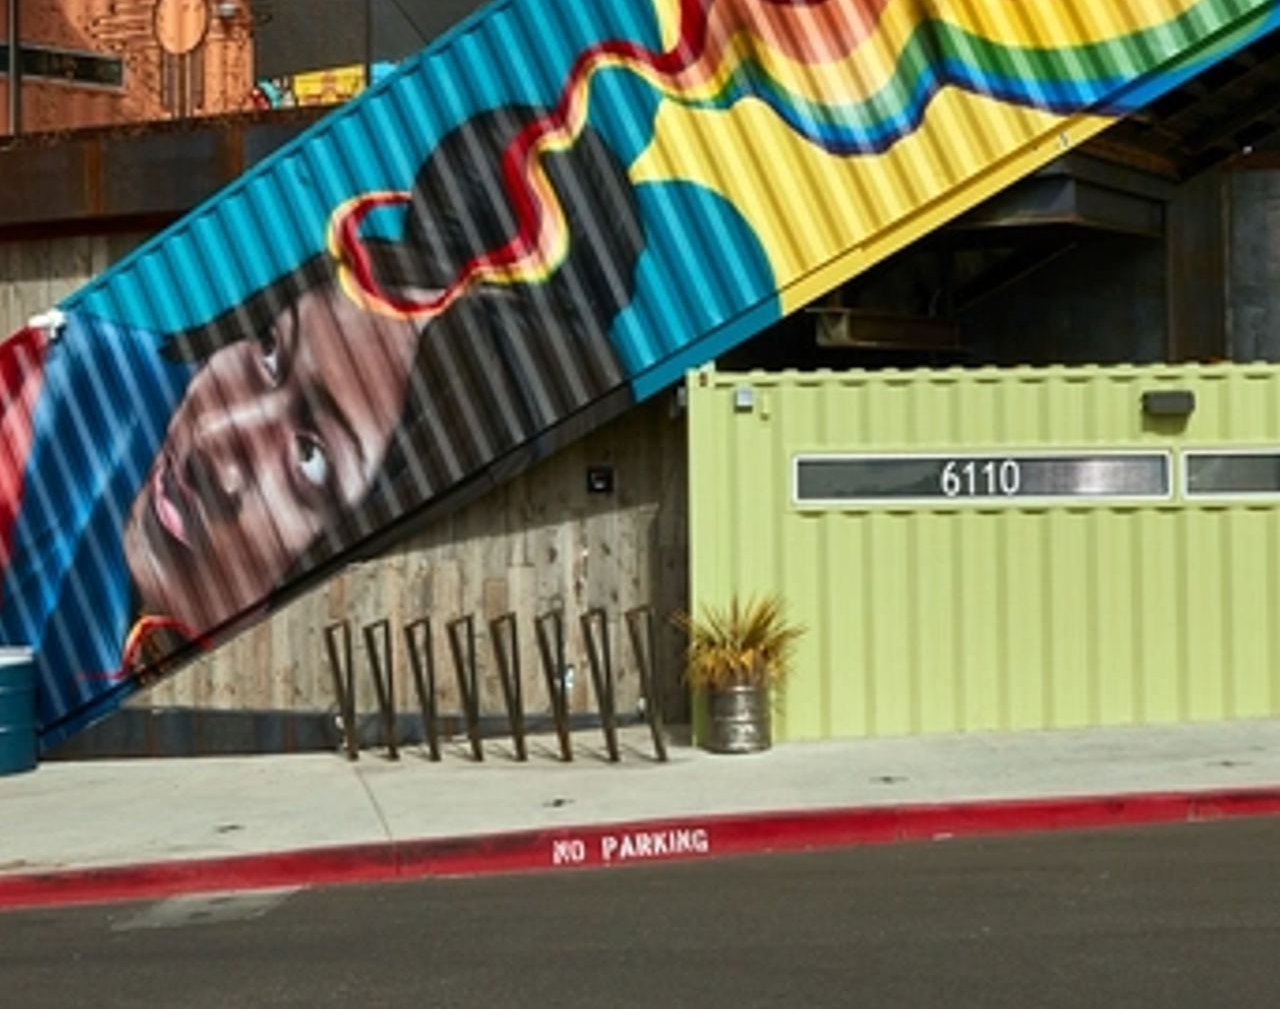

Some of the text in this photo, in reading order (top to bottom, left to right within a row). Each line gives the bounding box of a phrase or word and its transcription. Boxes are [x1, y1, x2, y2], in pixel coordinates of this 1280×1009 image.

[941, 460, 1021, 497] 6110
[552, 828, 709, 865] NO PARKING
